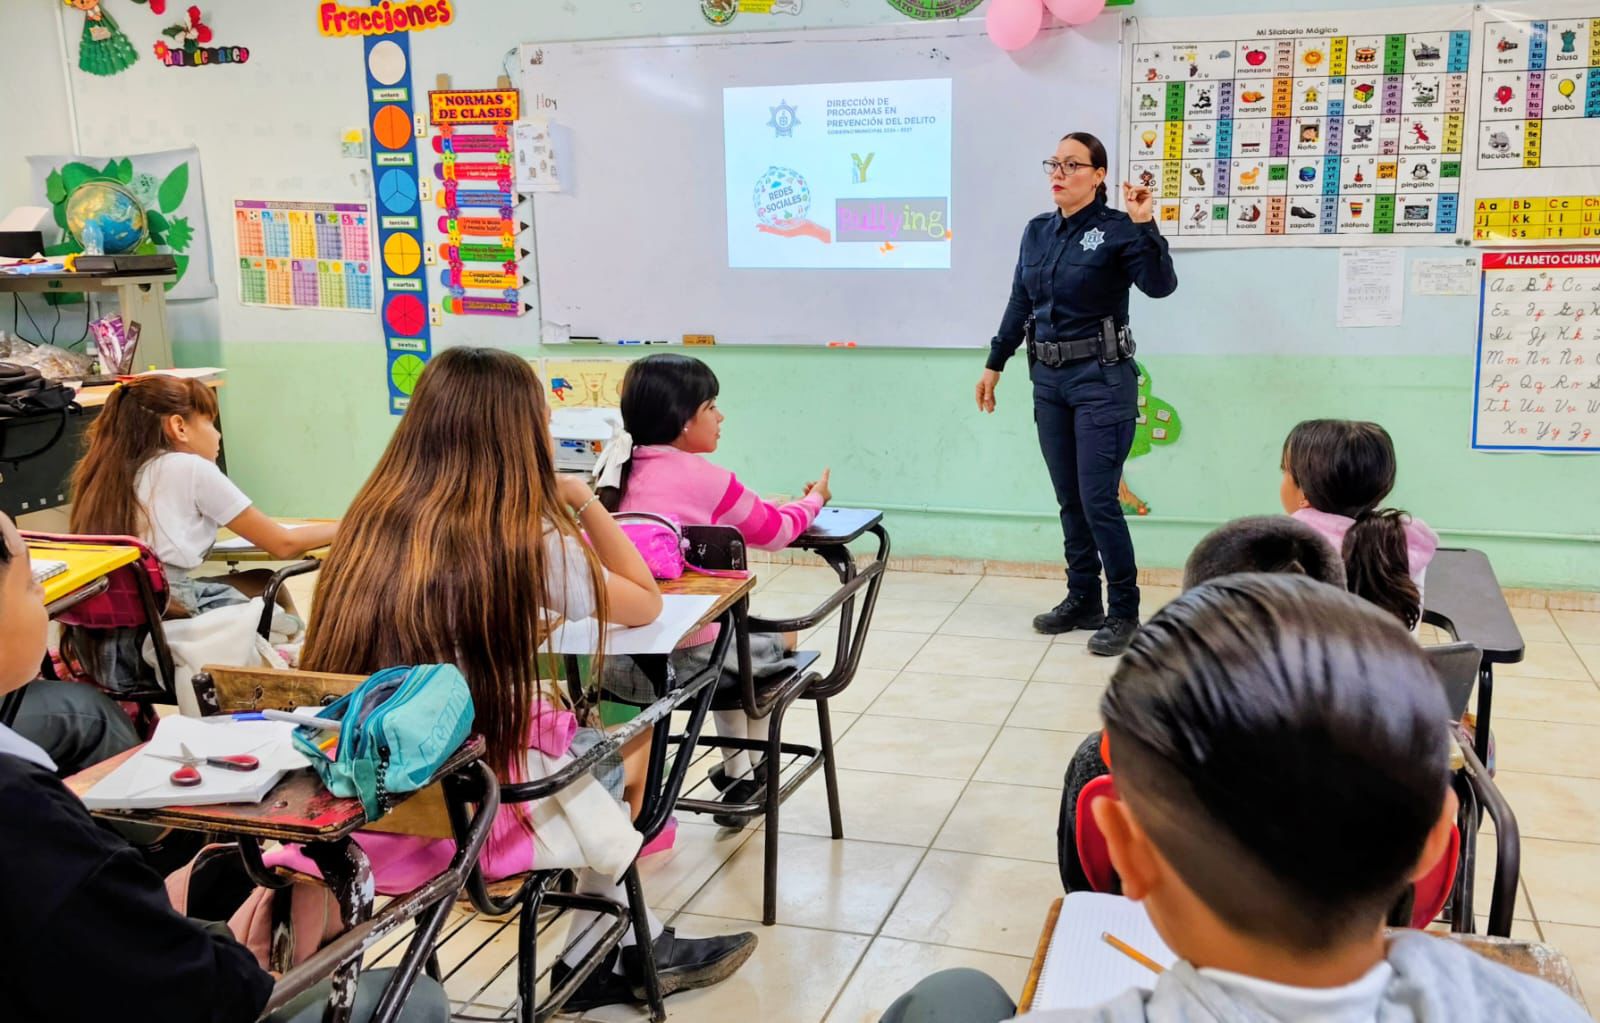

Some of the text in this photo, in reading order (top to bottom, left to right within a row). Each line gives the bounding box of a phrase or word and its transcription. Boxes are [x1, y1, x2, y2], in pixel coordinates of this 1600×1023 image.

[321, 0, 449, 32] Fracciones
[1268, 28, 1303, 36] Silabario
[445, 95, 503, 106] NORMAS
[537, 93, 557, 110] Hoy
[827, 97, 875, 107] DIRECCIÓN
[439, 108, 511, 119] DE CLASES
[827, 107, 882, 116] PROGRAMAS
[1552, 104, 1575, 112] globo
[827, 117, 883, 127] PREVENCIÓN
[904, 116, 936, 124] DELITO
[851, 152, 875, 184] Y
[768, 186, 793, 201] REDES
[766, 194, 801, 213] SOCIALES
[1478, 202, 1486, 210] A
[1513, 201, 1519, 209] B
[1524, 200, 1531, 209] b
[1549, 200, 1558, 208] C
[1585, 198, 1600, 206] Ch
[1478, 216, 1482, 224] J
[1485, 215, 1488, 226] j
[1513, 215, 1518, 223] K
[1523, 215, 1530, 223] k
[1548, 214, 1552, 222] L
[1477, 230, 1482, 238] R
[1512, 229, 1517, 237] S
[1548, 228, 1552, 236] T
[1558, 228, 1562, 236] t
[1584, 227, 1590, 236] U
[1505, 255, 1560, 265] ALFABETO
